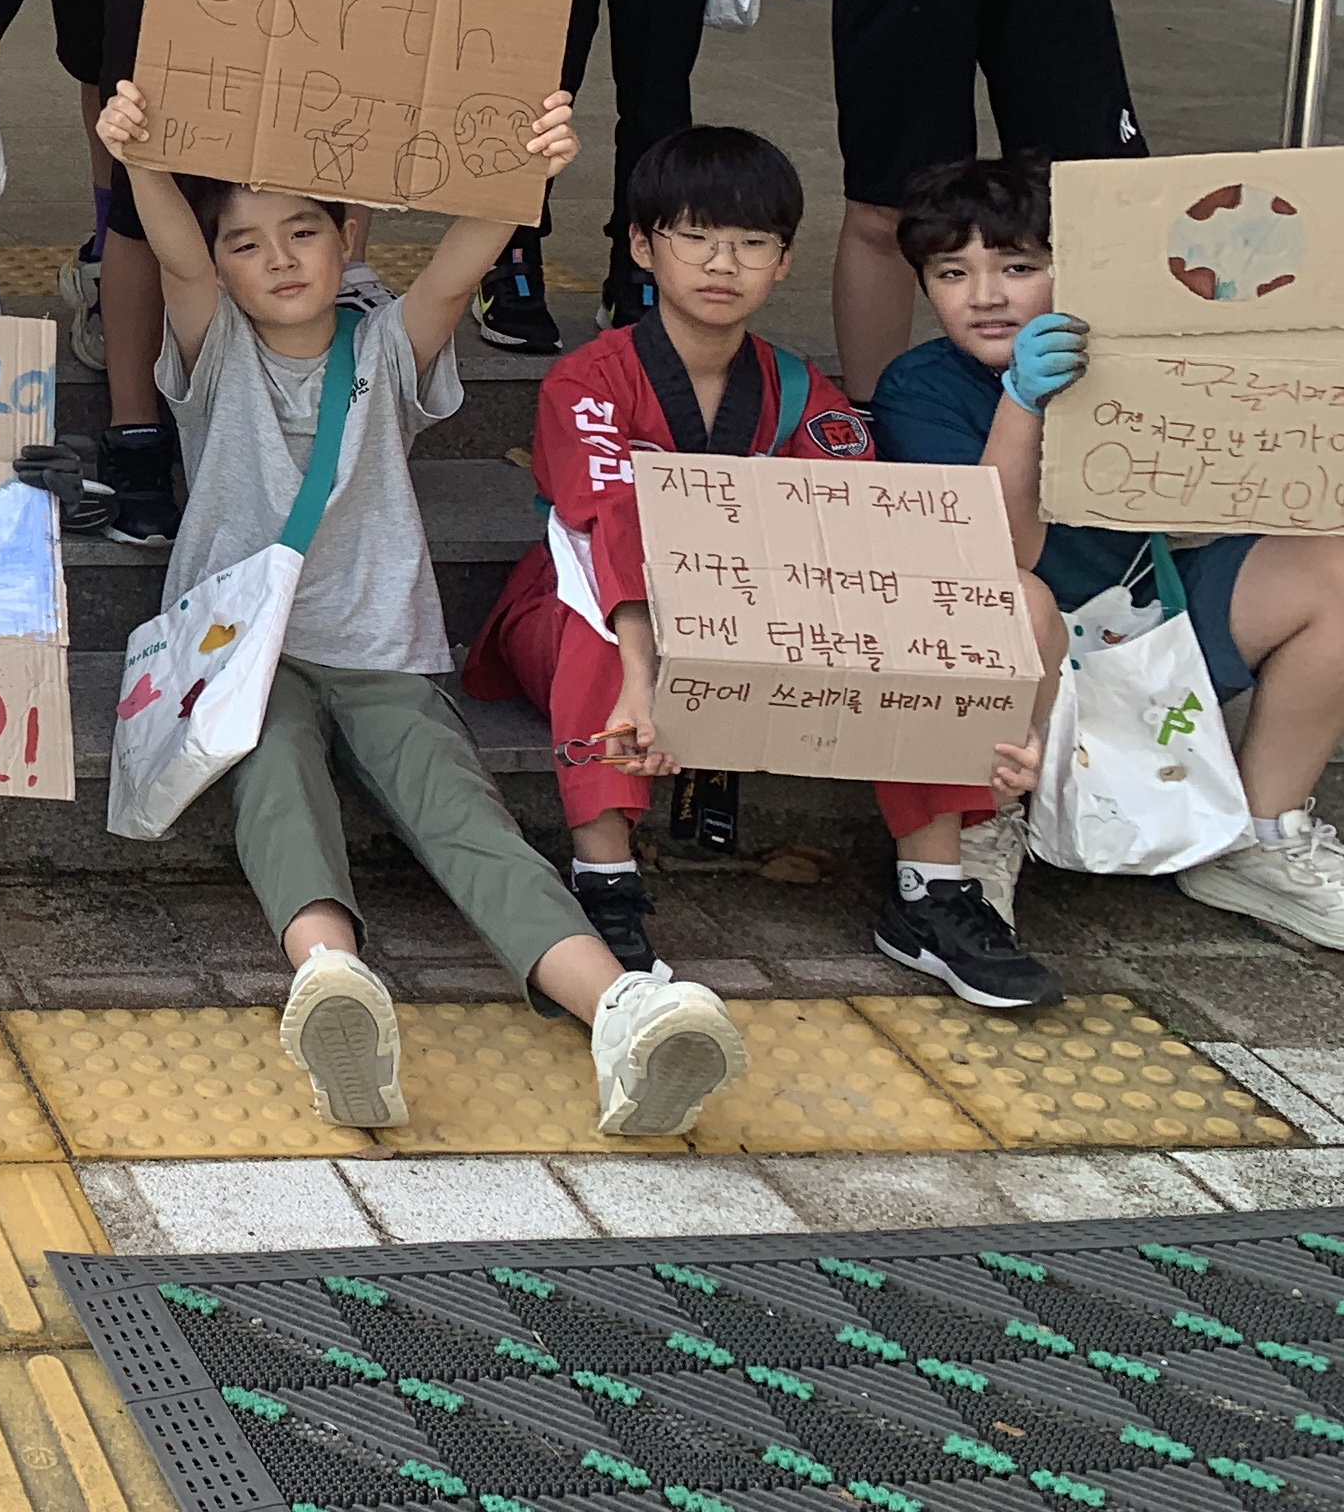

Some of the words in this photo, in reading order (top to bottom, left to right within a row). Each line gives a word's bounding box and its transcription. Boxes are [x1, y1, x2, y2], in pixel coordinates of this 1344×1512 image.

[652, 465, 740, 524] 지구를
[777, 478, 850, 508] 지켜
[870, 486, 972, 525] 주세요.
[669, 551, 758, 607] 지구를
[930, 579, 1015, 617] 플라스틱
[674, 615, 739, 646] 대신
[766, 621, 885, 672] 텀블러를
[906, 637, 1017, 677] 사용하고,
[669, 676, 751, 713] 땅에
[768, 682, 864, 714] 쓰레기를
[878, 690, 942, 711] 버리지
